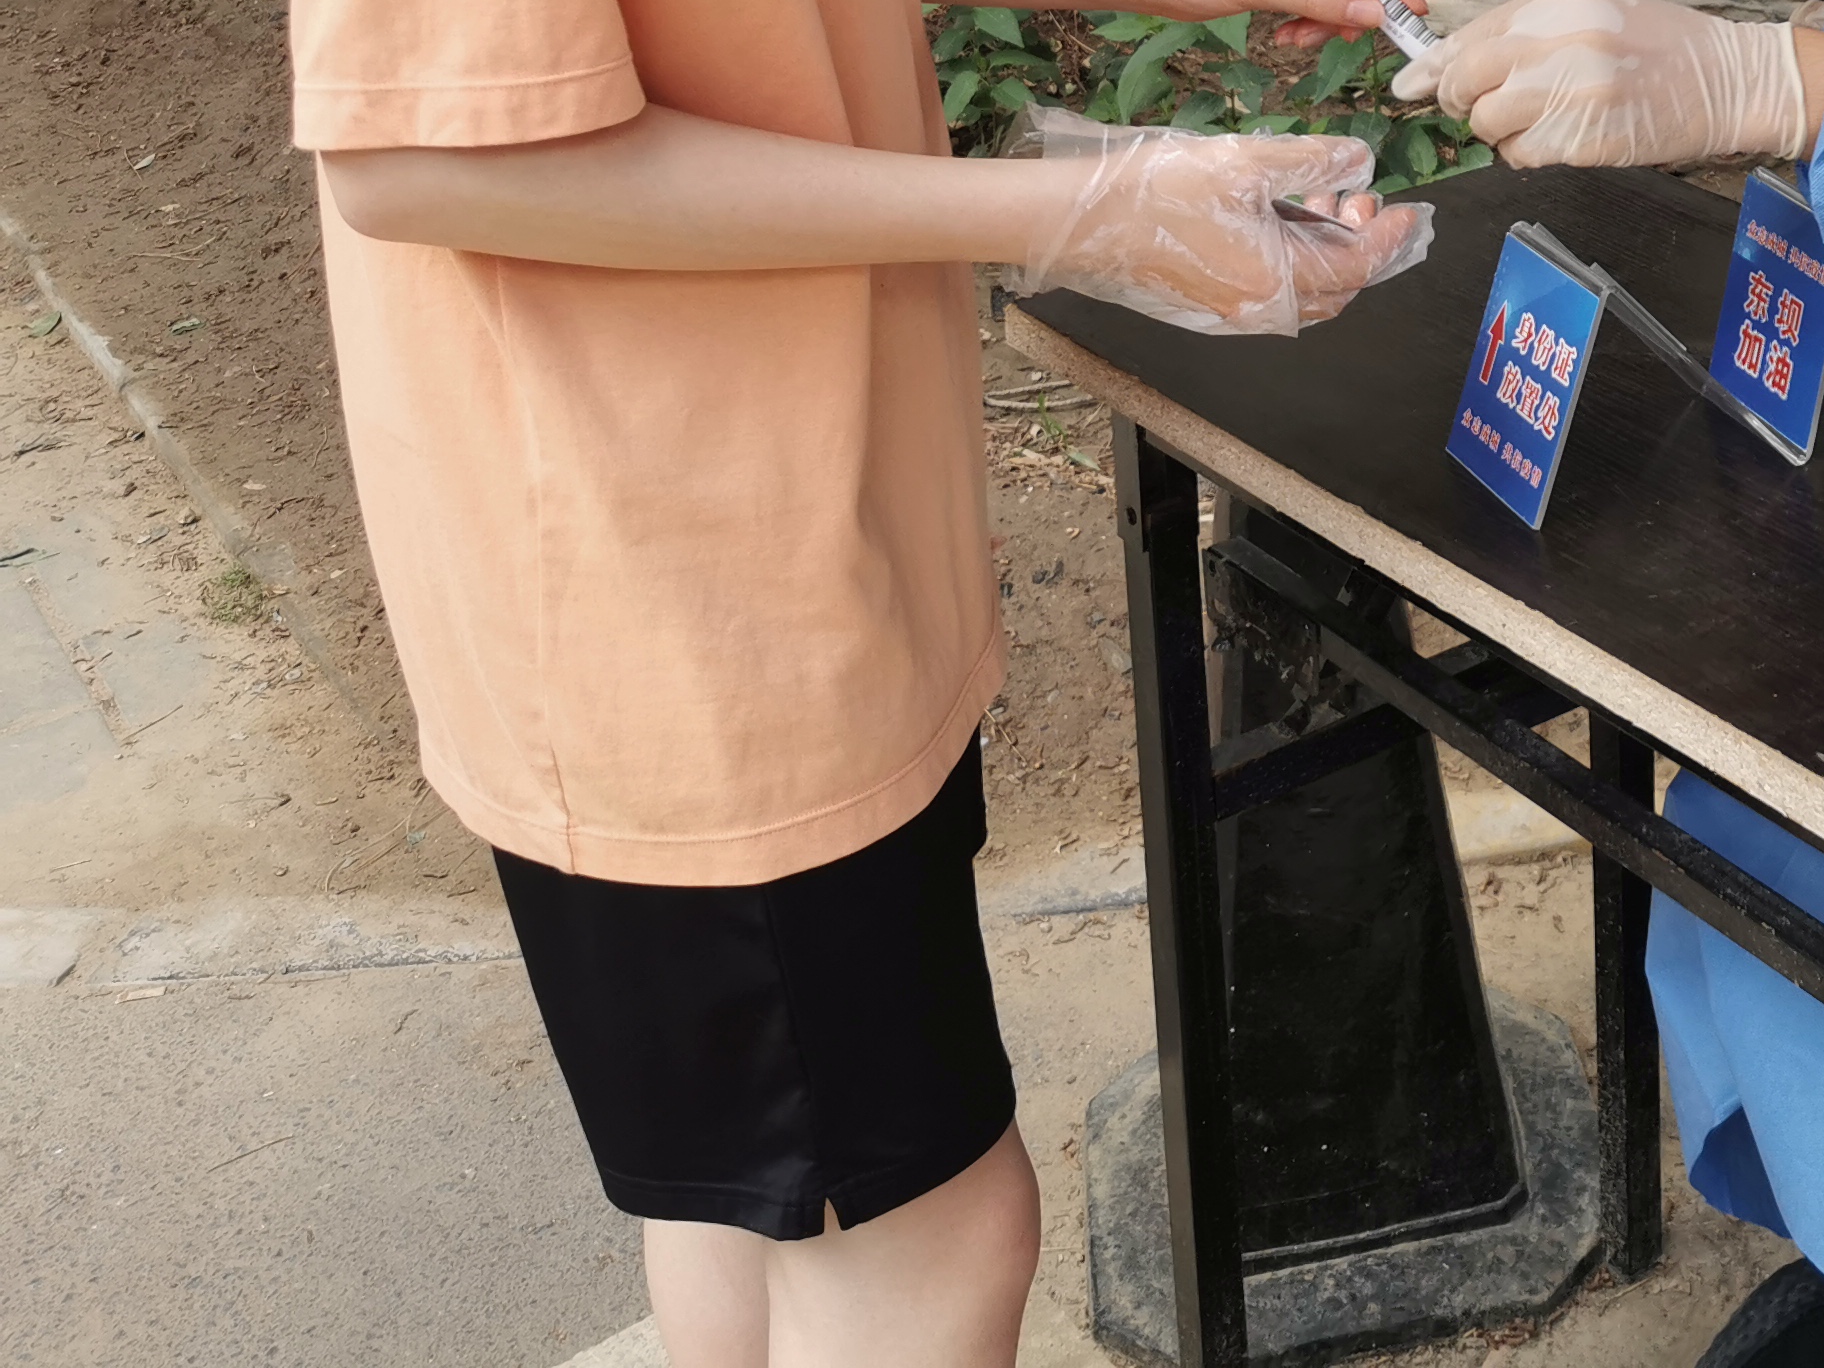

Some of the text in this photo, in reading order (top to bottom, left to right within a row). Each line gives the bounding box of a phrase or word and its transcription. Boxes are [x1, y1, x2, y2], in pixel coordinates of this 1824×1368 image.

[1744, 270, 1804, 346] 东坝
[1511, 312, 1578, 387] 身份证
[1734, 319, 1794, 401] 加油
[1496, 361, 1560, 440] 放置处
[1460, 408, 1543, 489] 众志成城 共抗疫情
